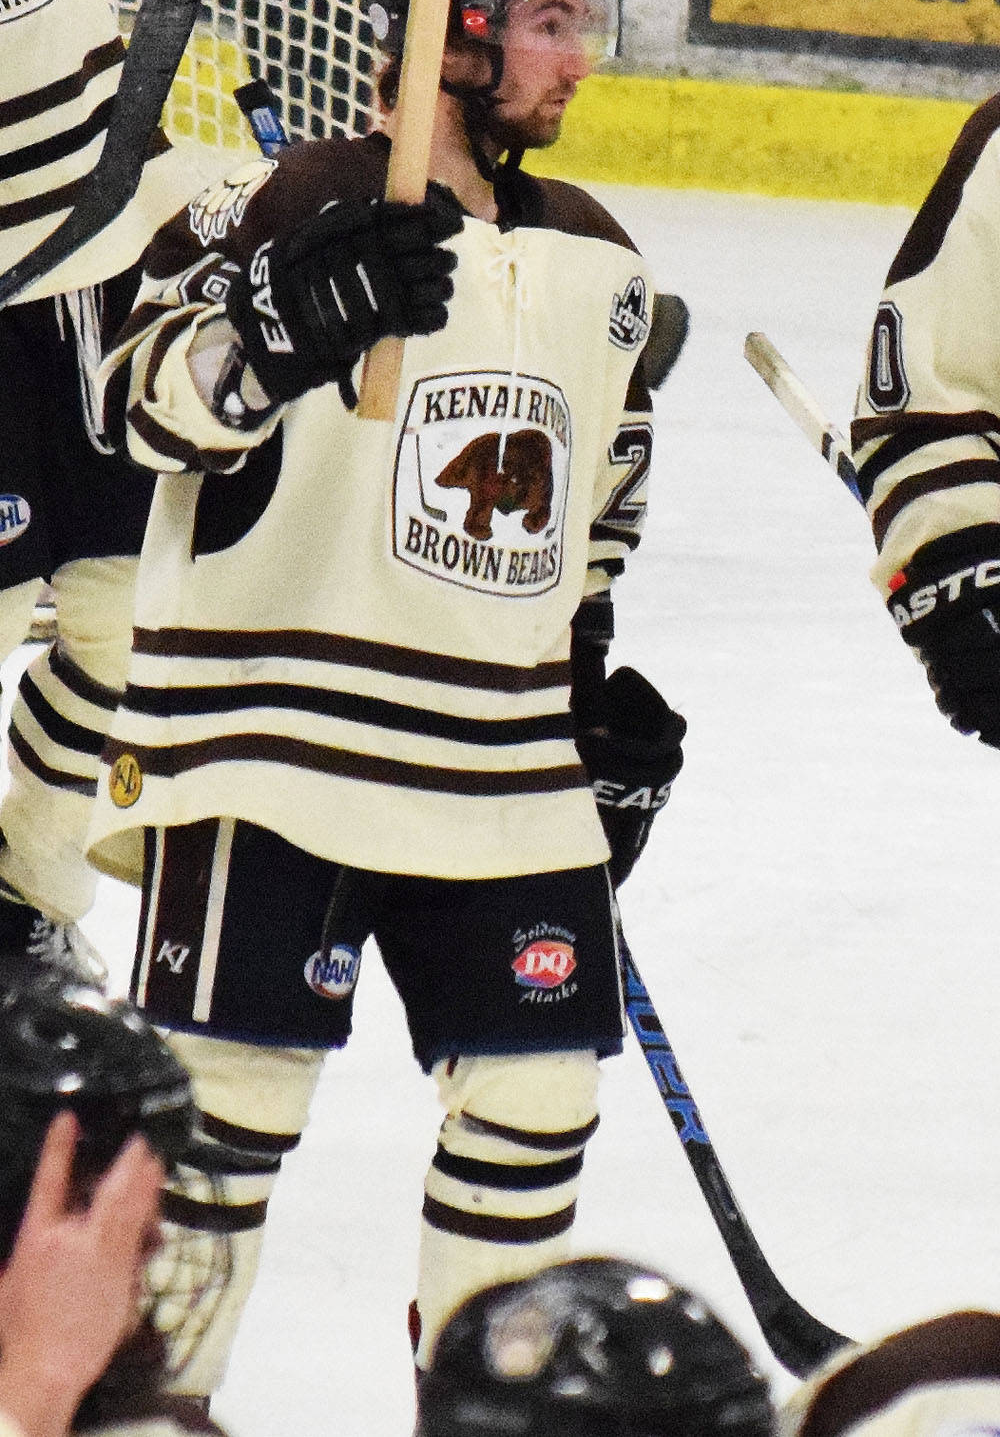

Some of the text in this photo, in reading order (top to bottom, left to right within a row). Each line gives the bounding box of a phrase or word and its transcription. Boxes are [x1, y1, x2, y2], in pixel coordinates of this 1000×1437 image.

[422, 385, 524, 425] KENAI
[404, 515, 505, 584] BROWN
[525, 951, 568, 976] DQ
